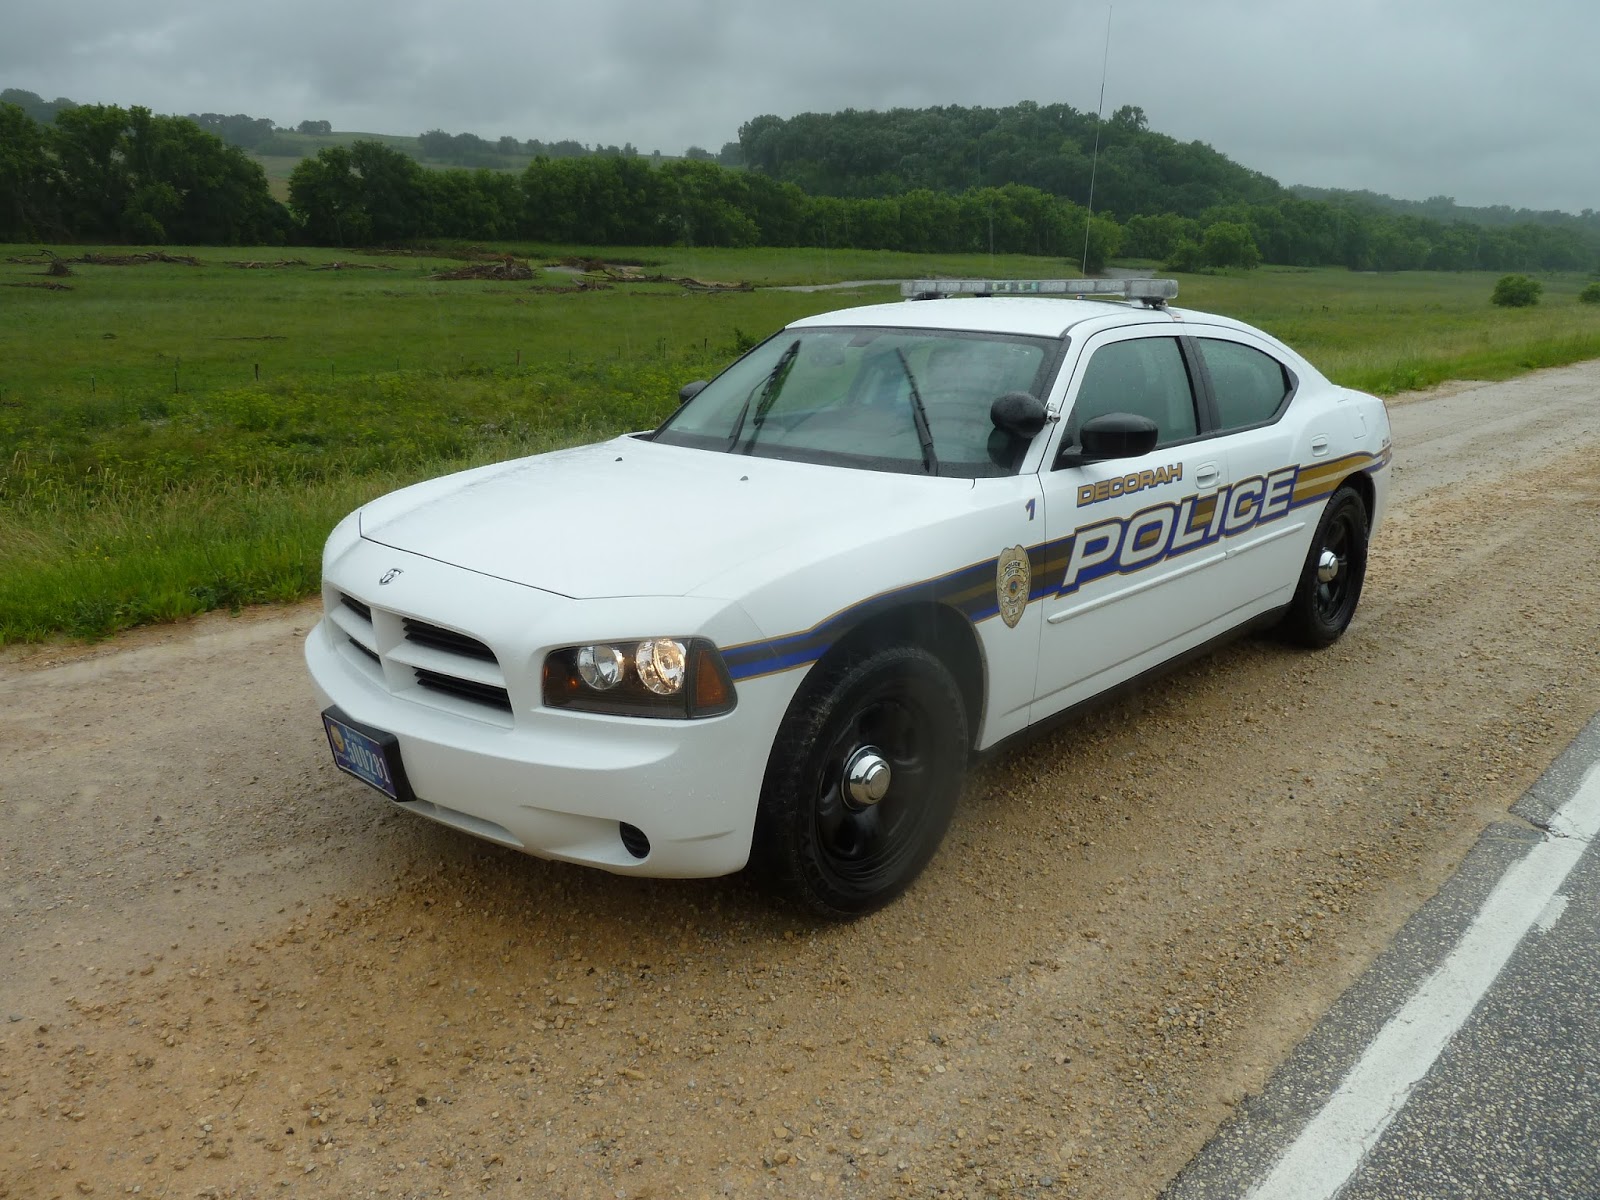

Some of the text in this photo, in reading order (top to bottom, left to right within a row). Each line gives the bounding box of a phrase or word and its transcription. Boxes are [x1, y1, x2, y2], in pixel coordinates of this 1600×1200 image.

[1077, 462, 1182, 508] DECORAH
[1025, 498, 1036, 521] 1
[1060, 466, 1298, 591] POLICE
[344, 738, 390, 784] 500281
